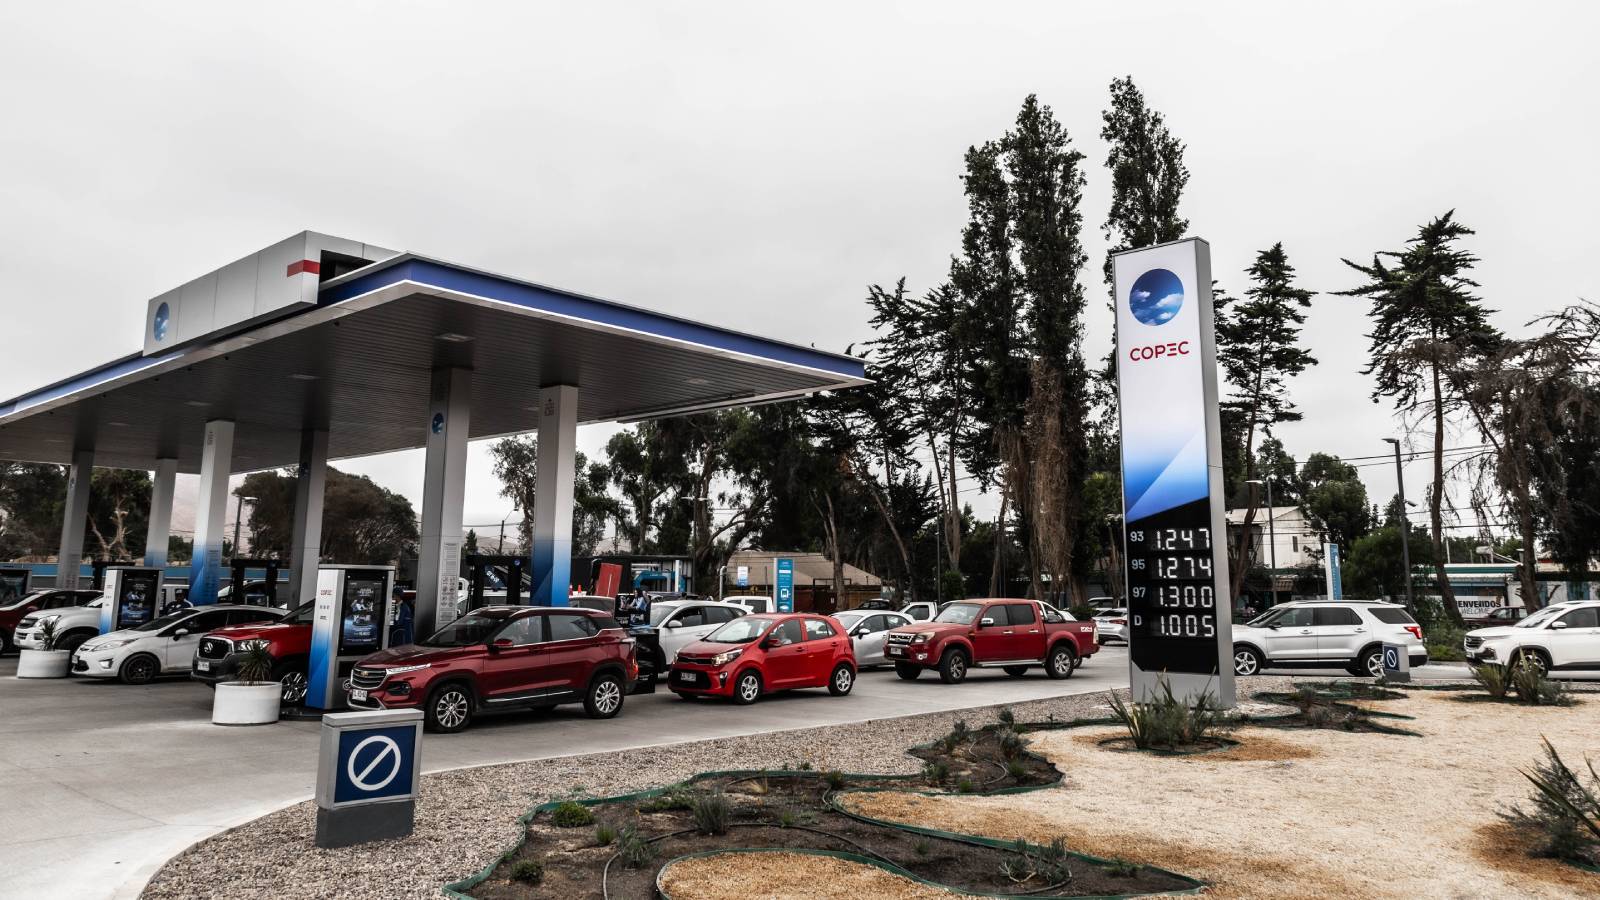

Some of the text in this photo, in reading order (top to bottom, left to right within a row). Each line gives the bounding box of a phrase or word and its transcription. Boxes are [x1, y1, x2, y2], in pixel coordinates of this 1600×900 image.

[1130, 341, 1190, 361] COPEC
[1130, 528, 1210, 550] 93 1.247
[1131, 557, 1212, 579] 95 1.274
[1132, 586, 1213, 608] 97 1.300
[1134, 615, 1214, 637] D 1.005
